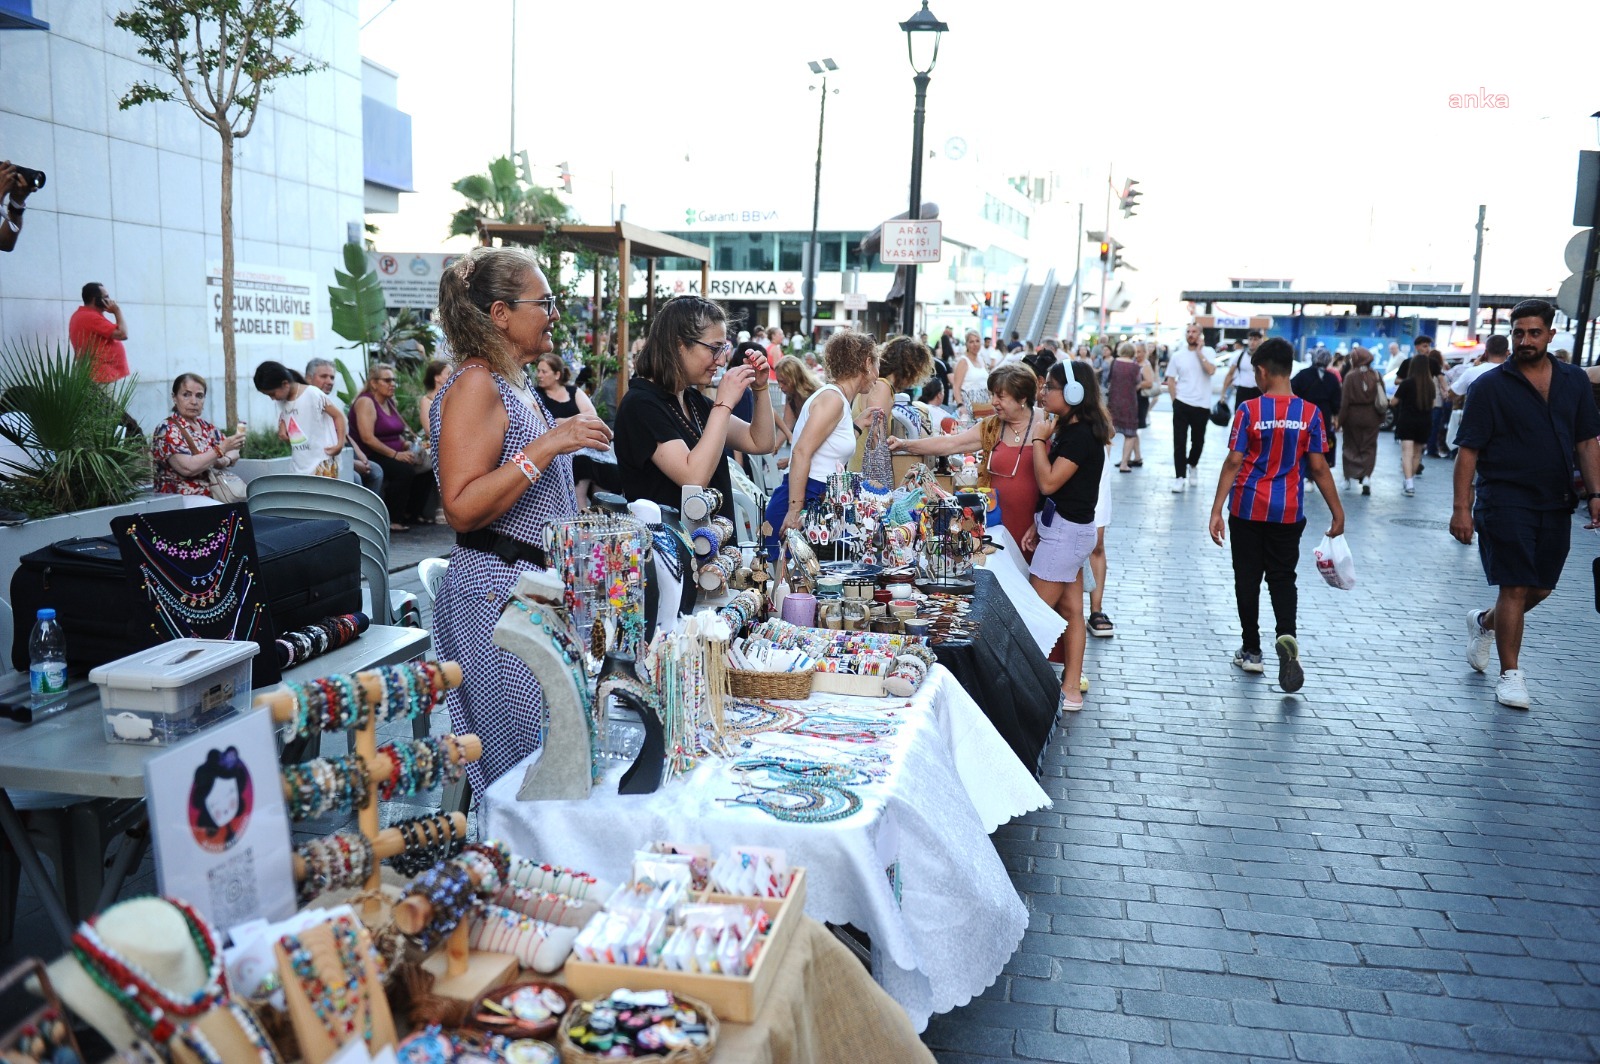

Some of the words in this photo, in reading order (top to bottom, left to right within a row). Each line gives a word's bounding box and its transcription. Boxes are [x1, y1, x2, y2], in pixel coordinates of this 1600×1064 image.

[698, 210, 738, 222] Garanti
[742, 210, 779, 222] BBVA
[898, 226, 928, 235] ARAÇ
[886, 249, 939, 257] YASAKTIR
[689, 280, 777, 296] KRŞIYAKA
[214, 293, 252, 312] ÇCUK
[255, 293, 311, 316] İŞÇİLİĞİYLE
[215, 317, 273, 334] MCADELE
[275, 320, 290, 335] ET!
